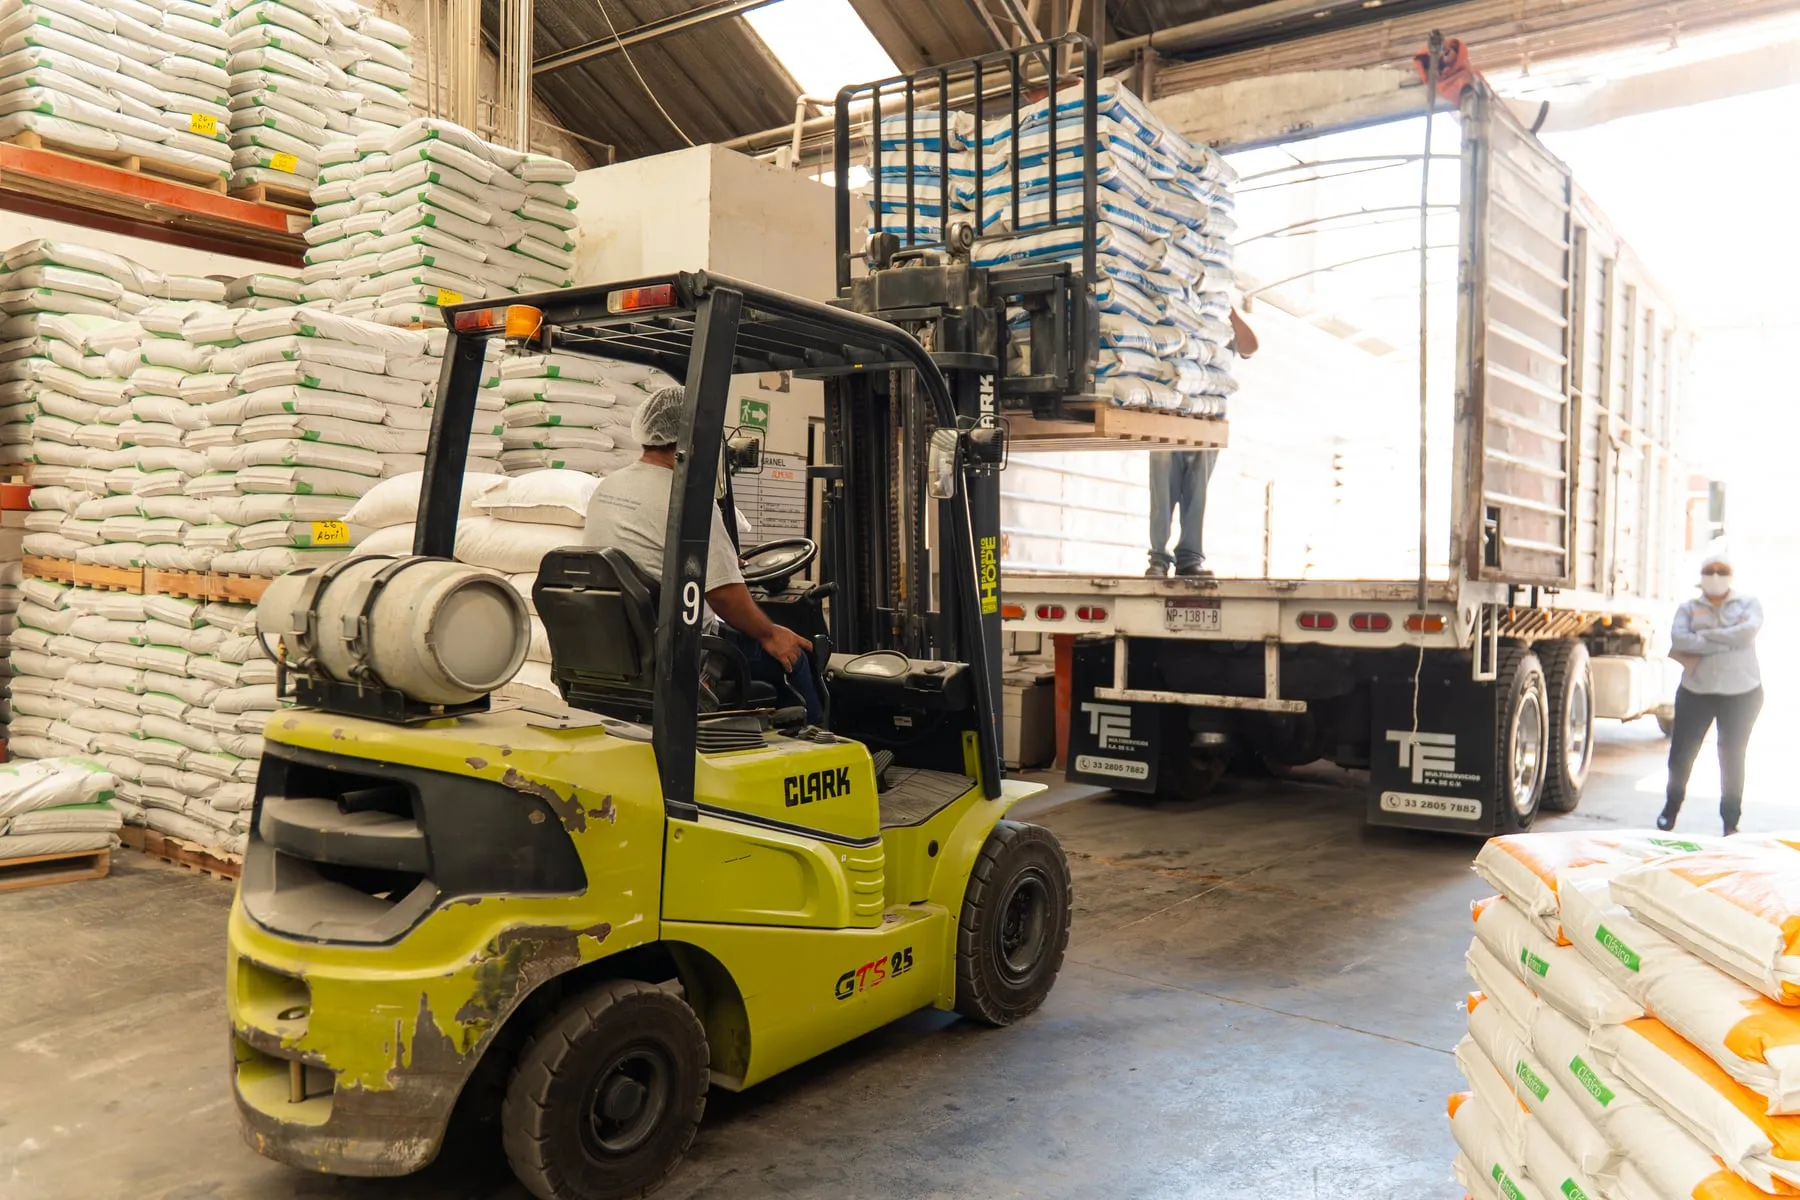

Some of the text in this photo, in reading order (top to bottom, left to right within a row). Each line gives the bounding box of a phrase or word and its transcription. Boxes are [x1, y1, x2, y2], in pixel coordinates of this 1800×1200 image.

[317, 527, 343, 541] Abril
[981, 536, 997, 601] HOPE
[683, 581, 700, 625] 9
[1166, 608, 1218, 624] NP-1381-B
[1092, 761, 1102, 769] 33
[1104, 762, 1123, 772] 2805
[1424, 770, 1480, 781] MULTISERVICIOS
[784, 767, 850, 808] CLARK
[1404, 798, 1476, 814] 33 2805 7882
[1603, 934, 1631, 965] Clásico
[834, 947, 913, 1000] GTS 25
[1577, 1065, 1602, 1098] Clásico
